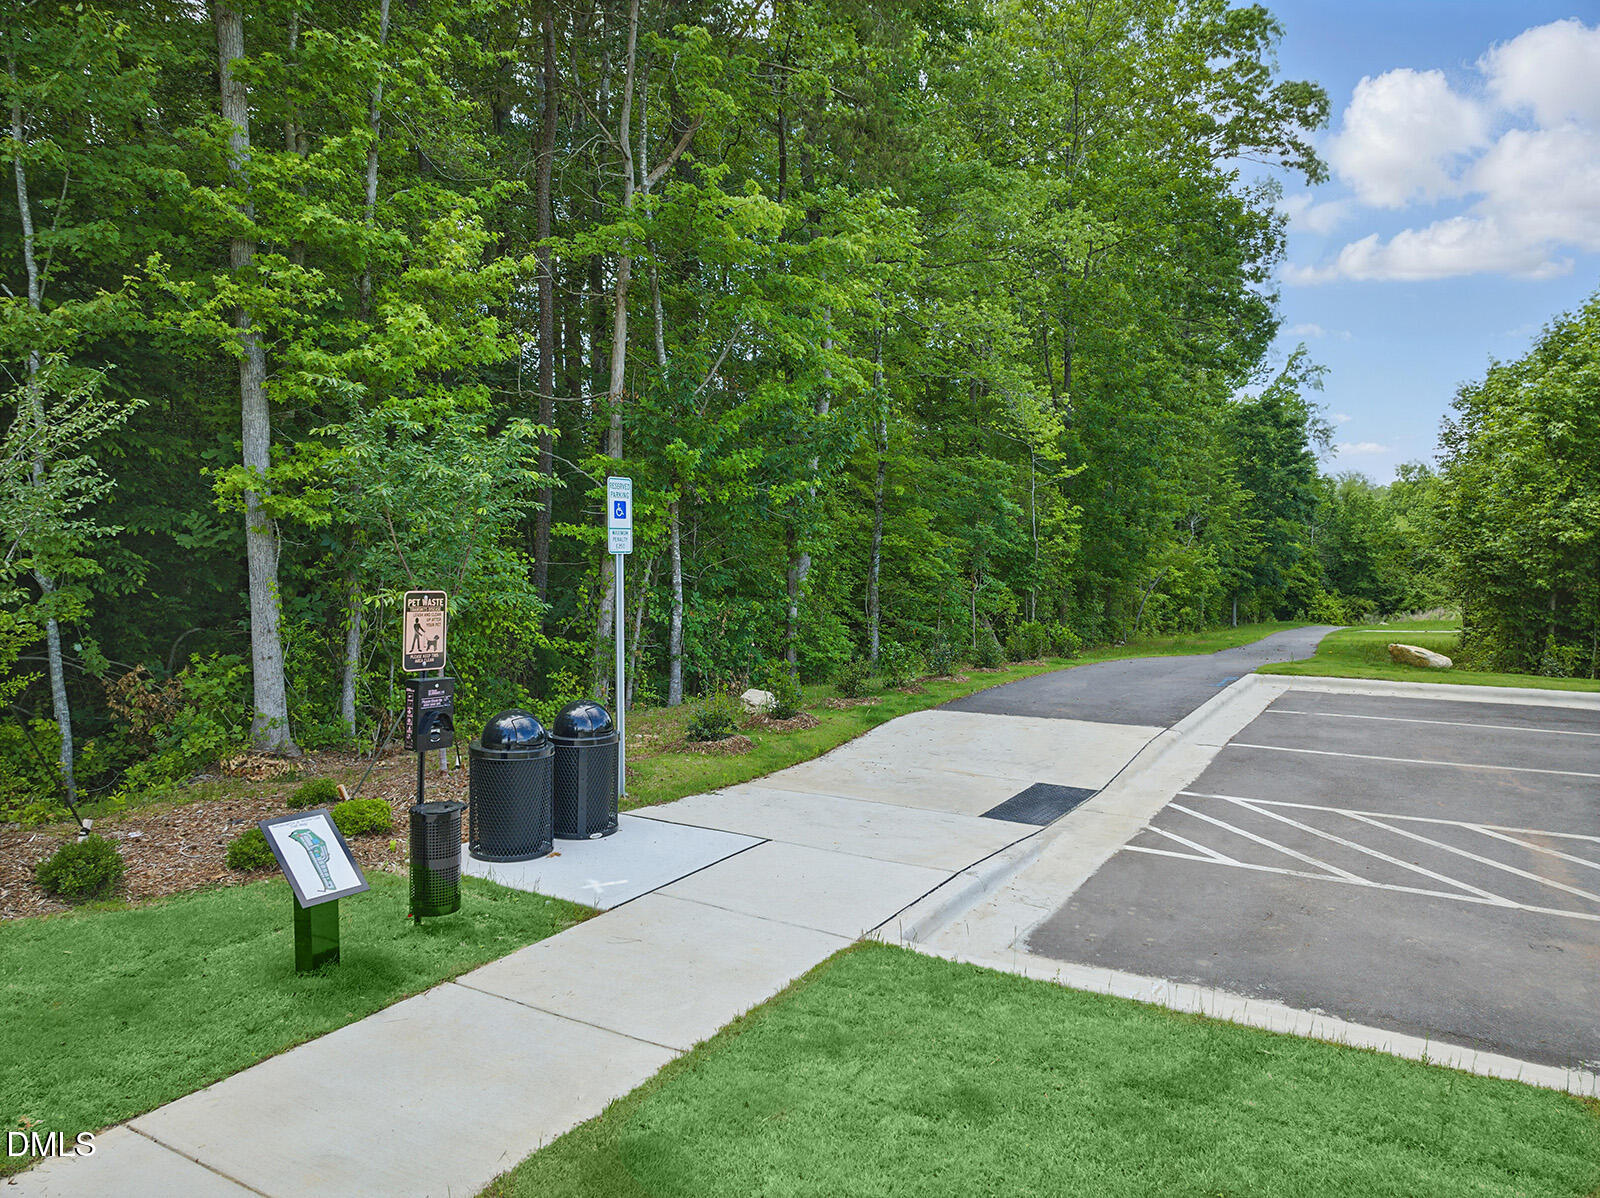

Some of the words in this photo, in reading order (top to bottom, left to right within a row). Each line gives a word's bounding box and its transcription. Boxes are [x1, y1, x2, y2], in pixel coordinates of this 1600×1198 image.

[609, 482, 630, 490] RESERVED
[610, 491, 629, 499] PARKING
[408, 598, 420, 606] PET
[422, 598, 444, 607] WASTE
